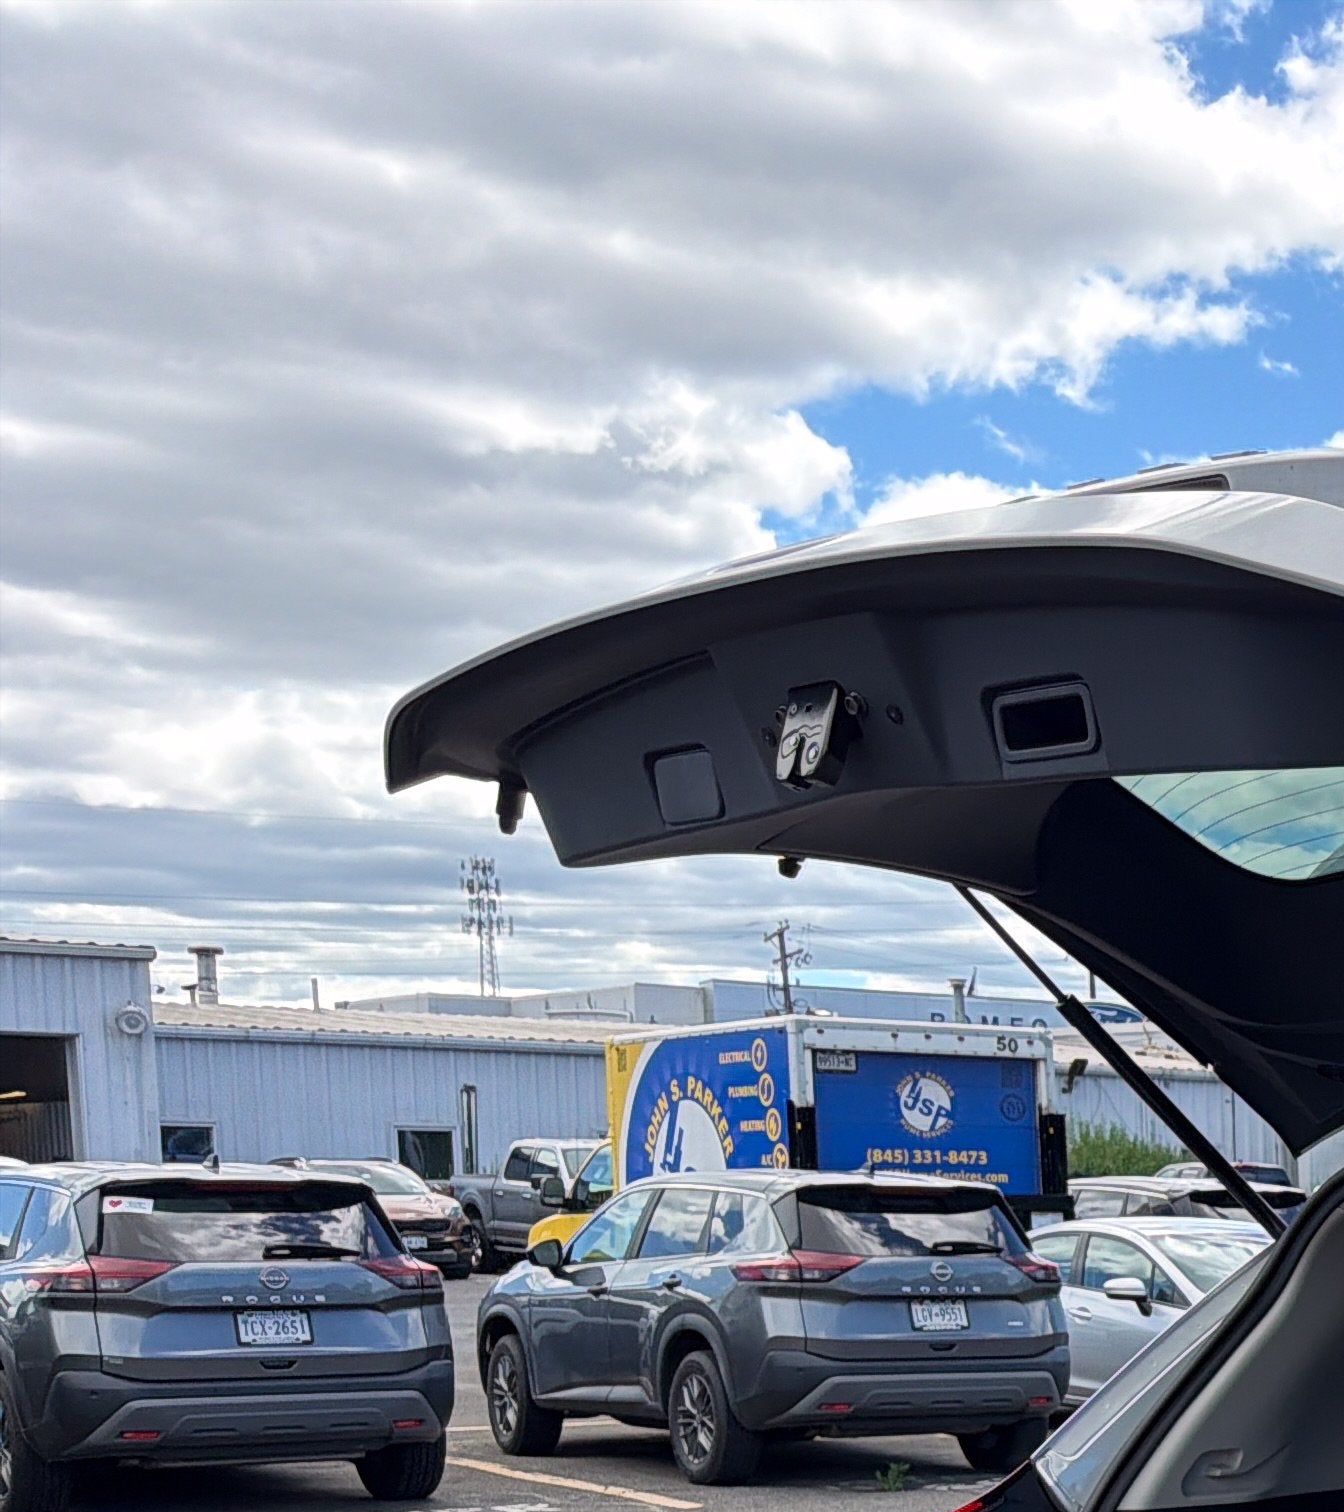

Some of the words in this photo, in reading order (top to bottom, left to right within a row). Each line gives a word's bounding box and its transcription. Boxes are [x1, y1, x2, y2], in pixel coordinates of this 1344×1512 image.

[996, 1036, 1019, 1053] 50
[644, 1091, 669, 1163] JOHN
[670, 1078, 684, 1101] S.
[687, 1075, 734, 1159] PARKER
[866, 1148, 909, 1166] (845)
[912, 1150, 988, 1165] 331-8473
